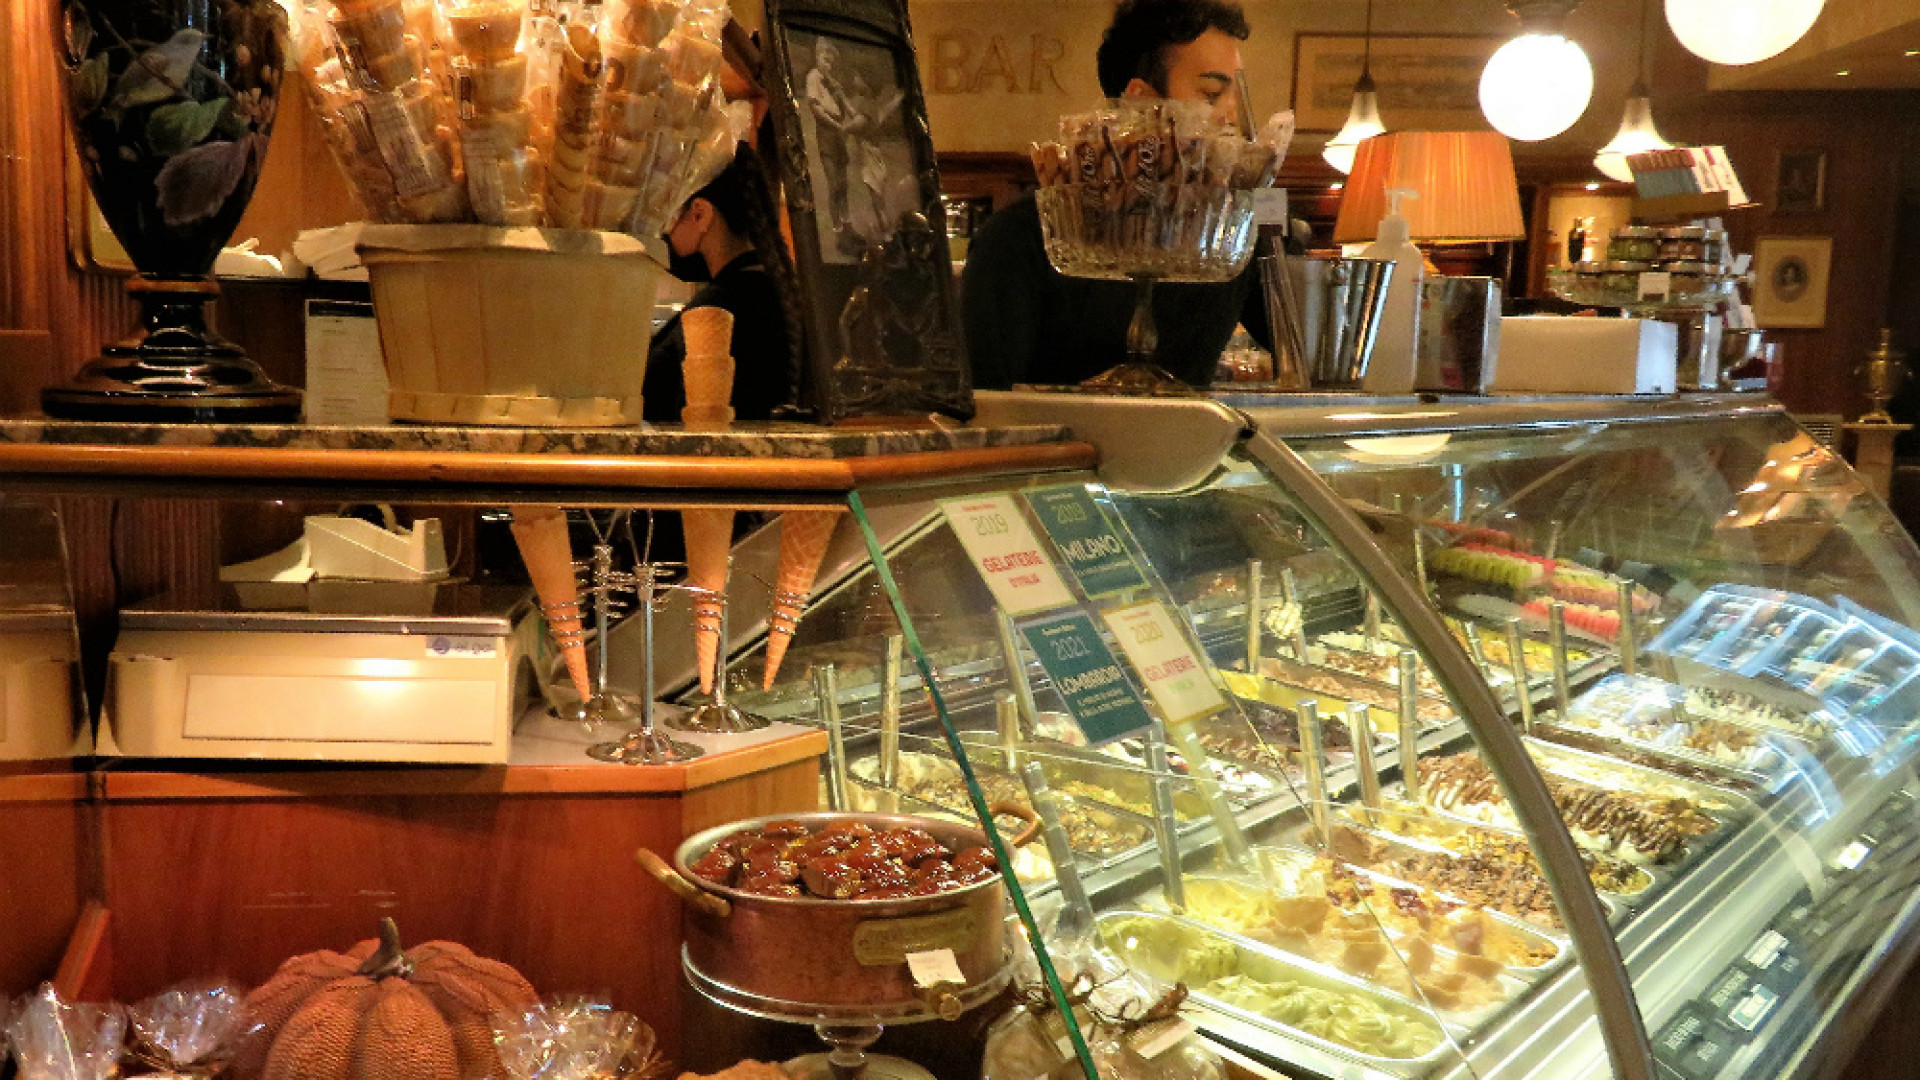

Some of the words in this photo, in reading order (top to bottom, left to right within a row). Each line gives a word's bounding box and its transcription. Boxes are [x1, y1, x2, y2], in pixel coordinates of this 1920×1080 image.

[926, 33, 1069, 96] BAR
[970, 513, 1009, 535] 2019
[1058, 534, 1122, 562] MILANO
[982, 550, 1045, 573] GELATERIE
[1049, 636, 1091, 660] 2021
[1144, 655, 1197, 682] GELATERIE
